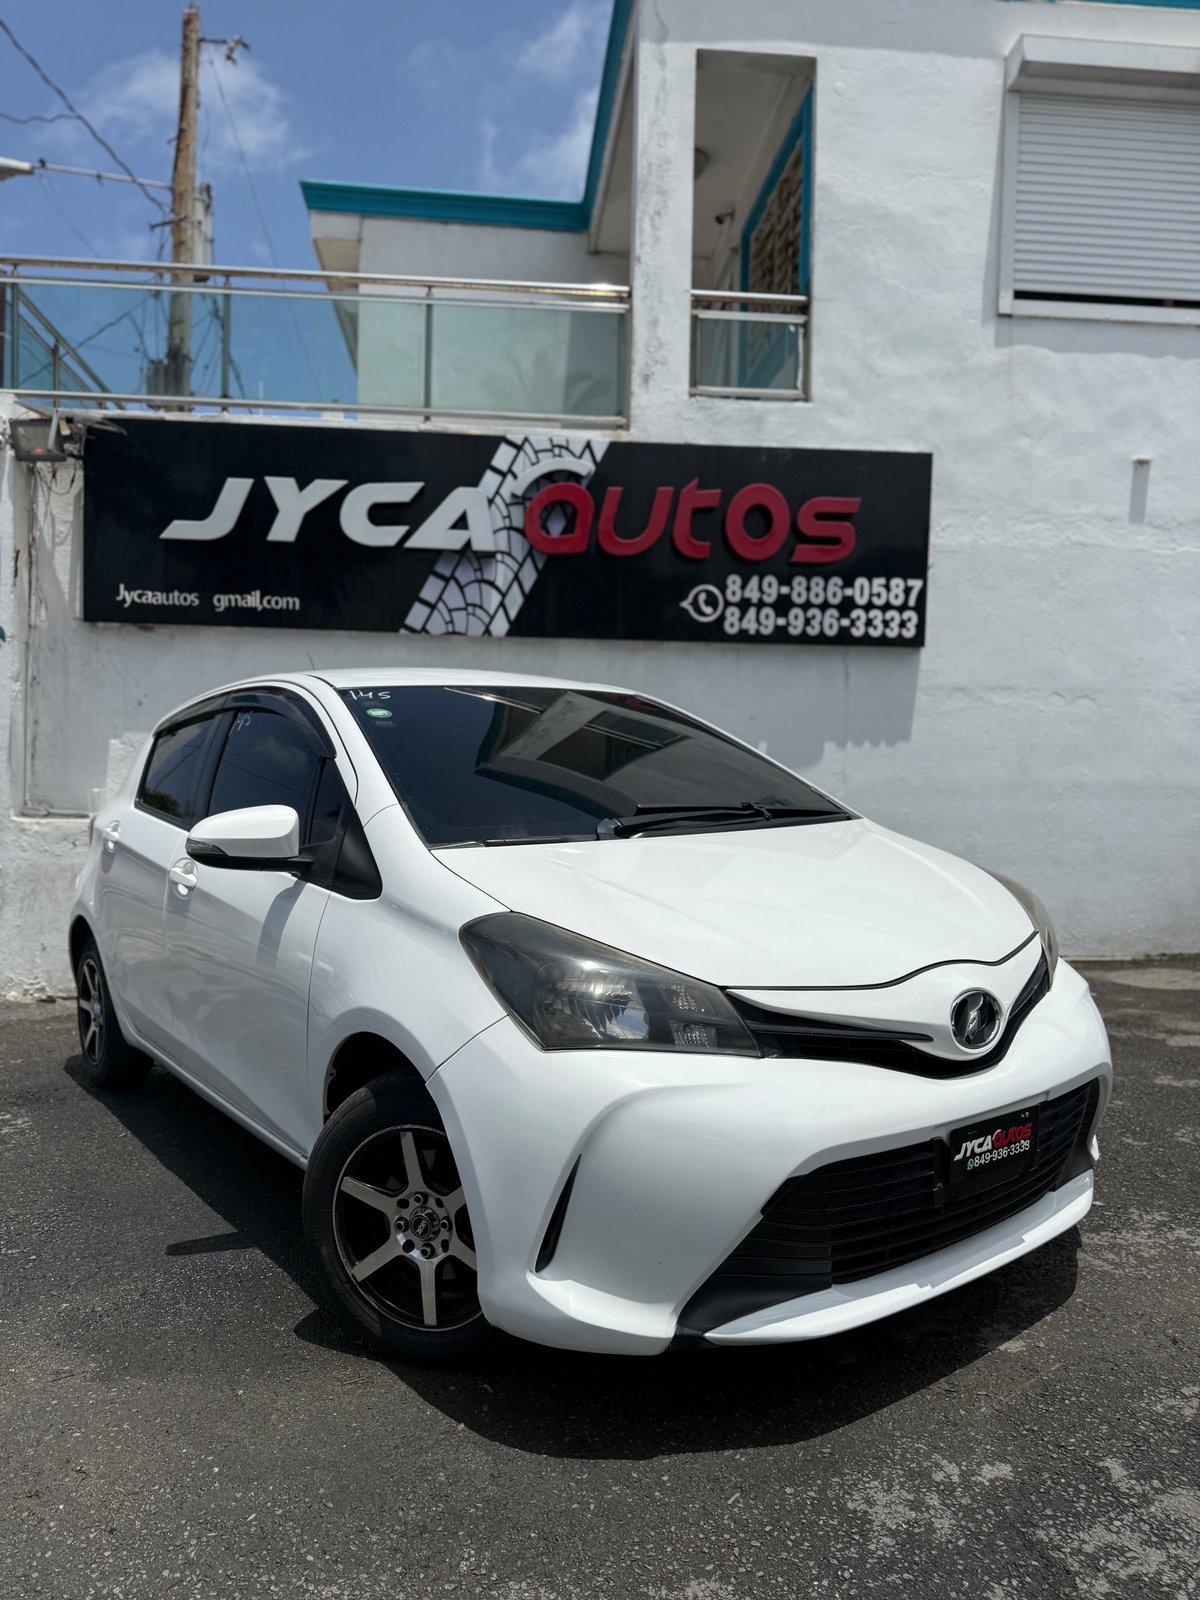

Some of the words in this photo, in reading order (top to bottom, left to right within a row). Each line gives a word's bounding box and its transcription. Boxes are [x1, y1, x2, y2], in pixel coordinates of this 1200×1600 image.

[160, 476, 496, 552] JYCA
[116, 583, 199, 608] Jycaautos
[725, 574, 924, 607] 849-886-0587
[723, 605, 918, 638] 849-936-3333
